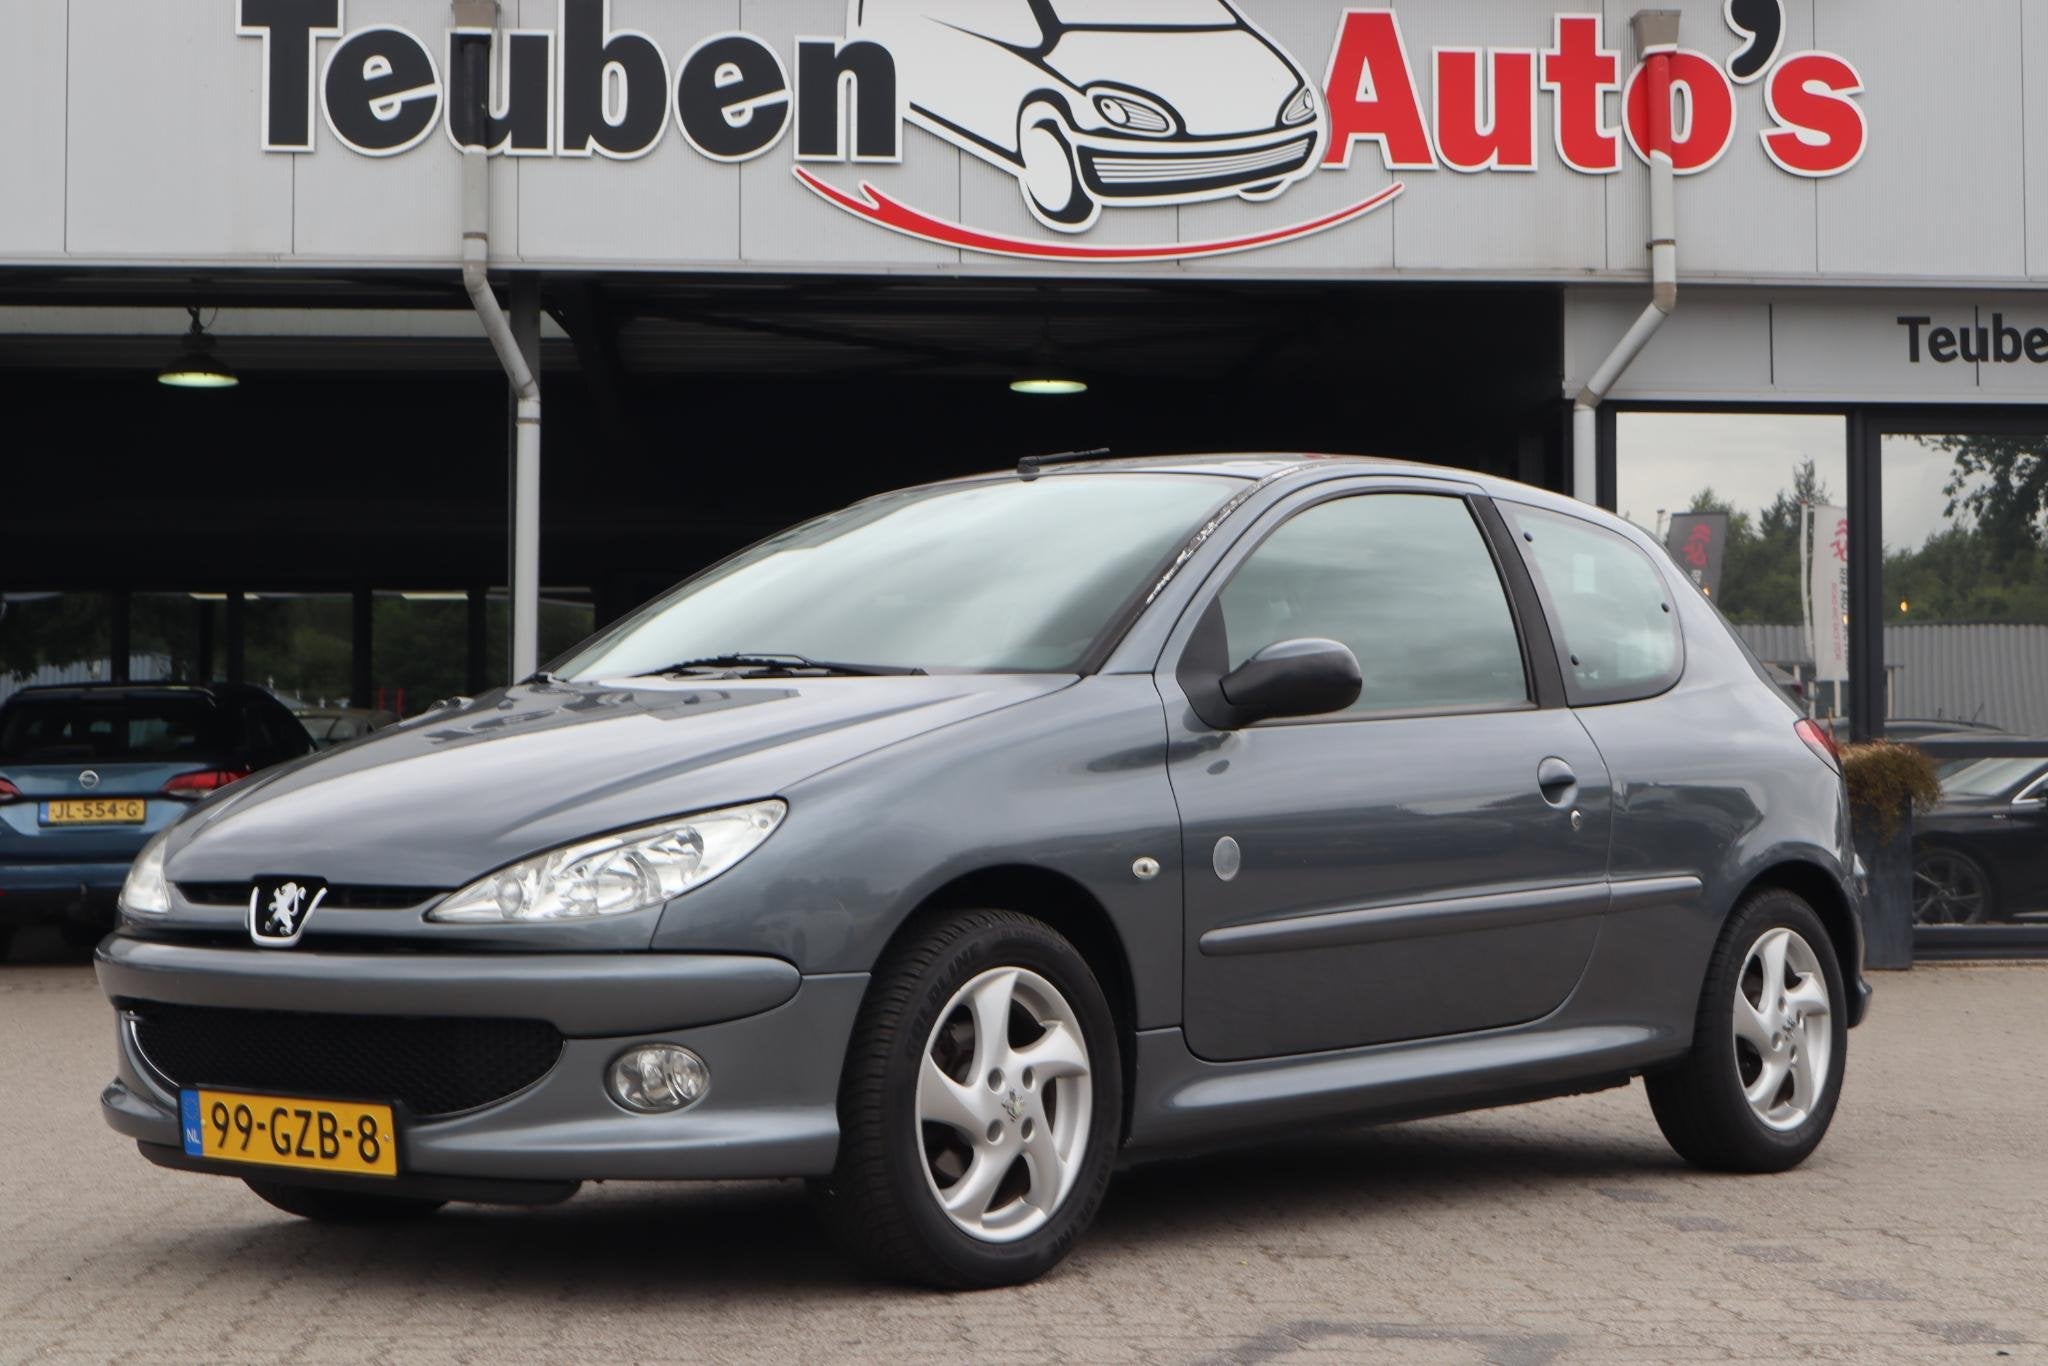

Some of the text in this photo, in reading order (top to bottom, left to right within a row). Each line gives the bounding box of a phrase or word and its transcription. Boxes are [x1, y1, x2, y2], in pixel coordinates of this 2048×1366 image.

[236, 0, 1867, 177] Teuben Auto's
[1897, 313, 2048, 363] Teube
[54, 801, 138, 819] JL-554-G
[186, 1127, 201, 1144] NL
[211, 1101, 380, 1164] 99-GZB-8
